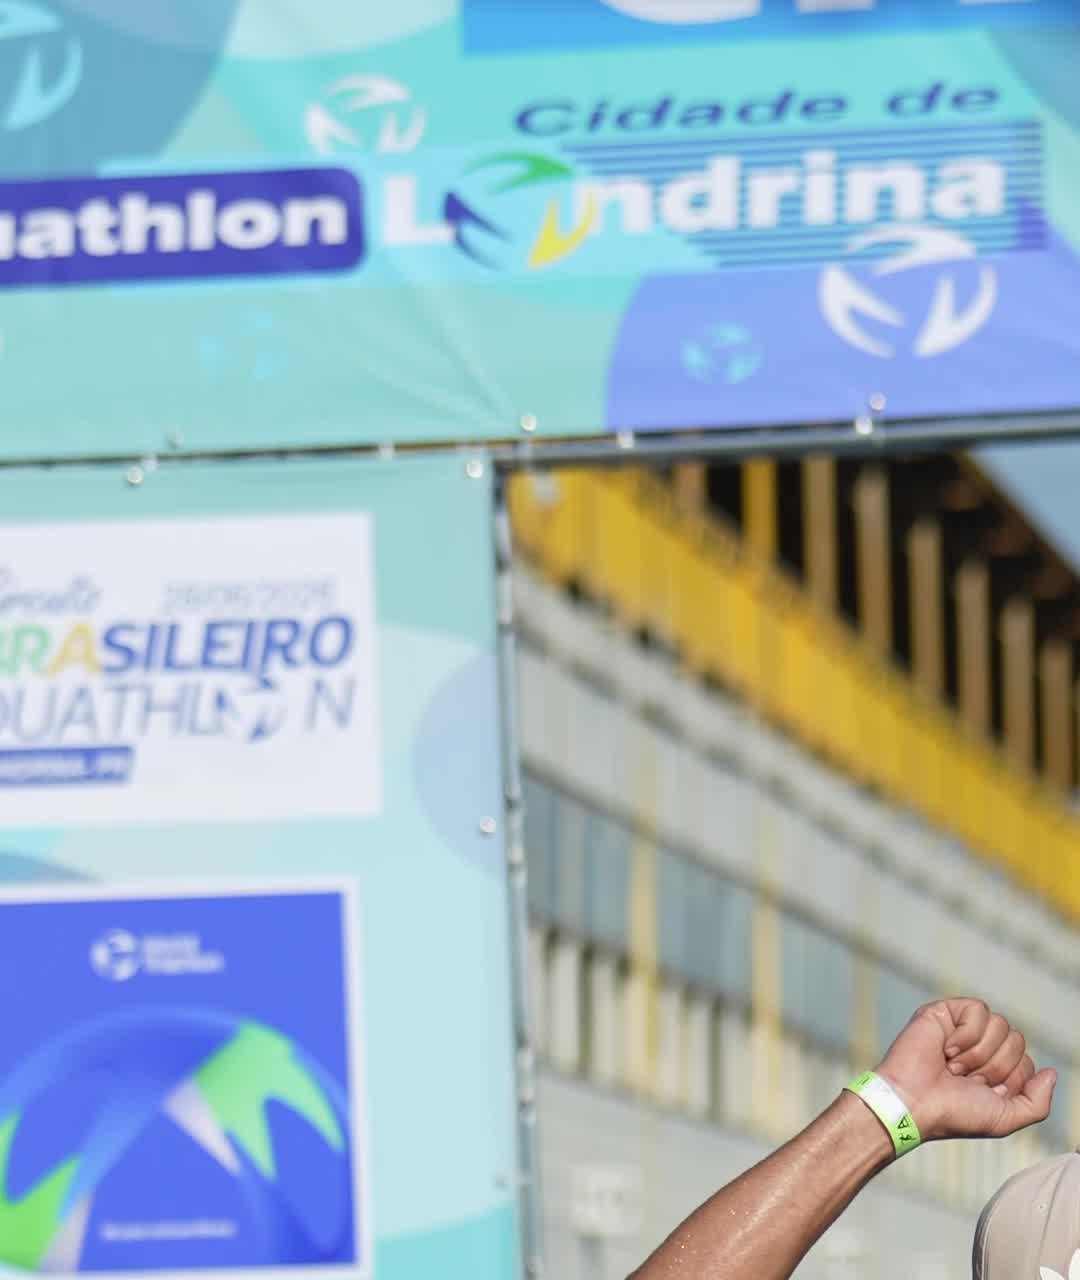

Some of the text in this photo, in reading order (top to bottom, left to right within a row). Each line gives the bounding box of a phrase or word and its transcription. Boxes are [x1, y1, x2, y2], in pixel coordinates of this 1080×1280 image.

[514, 80, 998, 137] Cidade de
[0, 189, 348, 260] athlon
[0, 616, 355, 677] RASILEIRO
[0, 675, 357, 743] UATHLON
